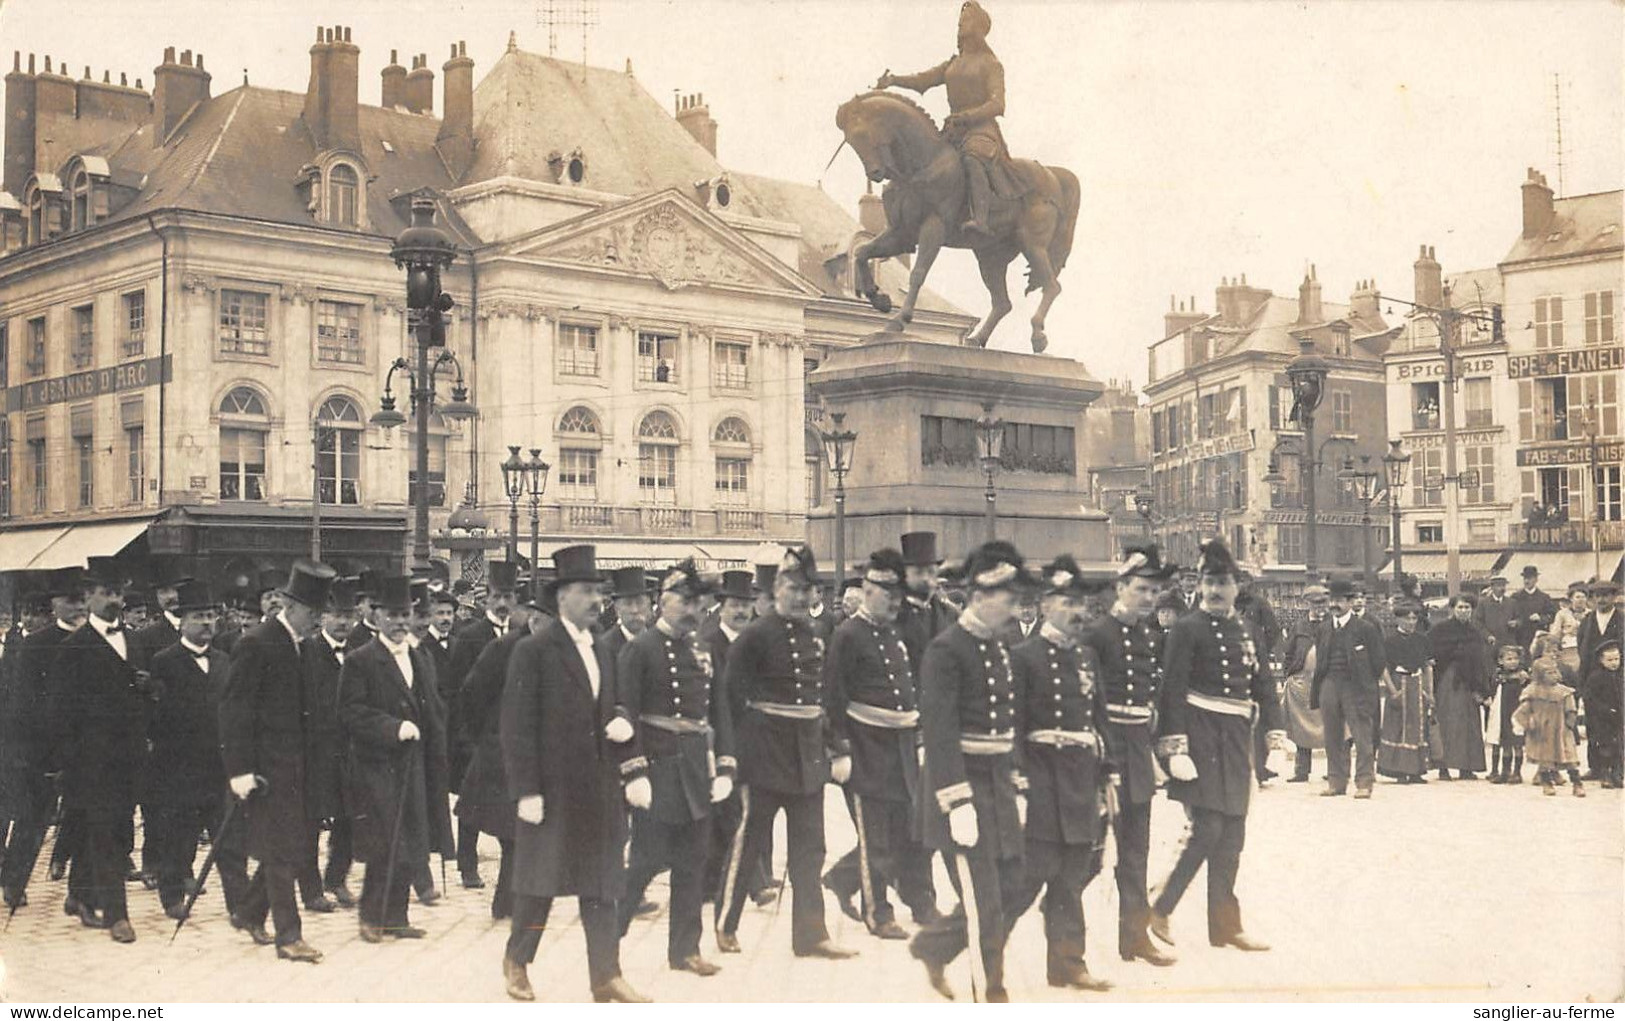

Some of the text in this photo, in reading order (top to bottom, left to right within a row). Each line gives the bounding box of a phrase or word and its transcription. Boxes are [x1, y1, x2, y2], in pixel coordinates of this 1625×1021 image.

[40, 375, 94, 401] JEANNE
[101, 364, 147, 390] D'ARC
[1398, 360, 1494, 379] EPICRIE
